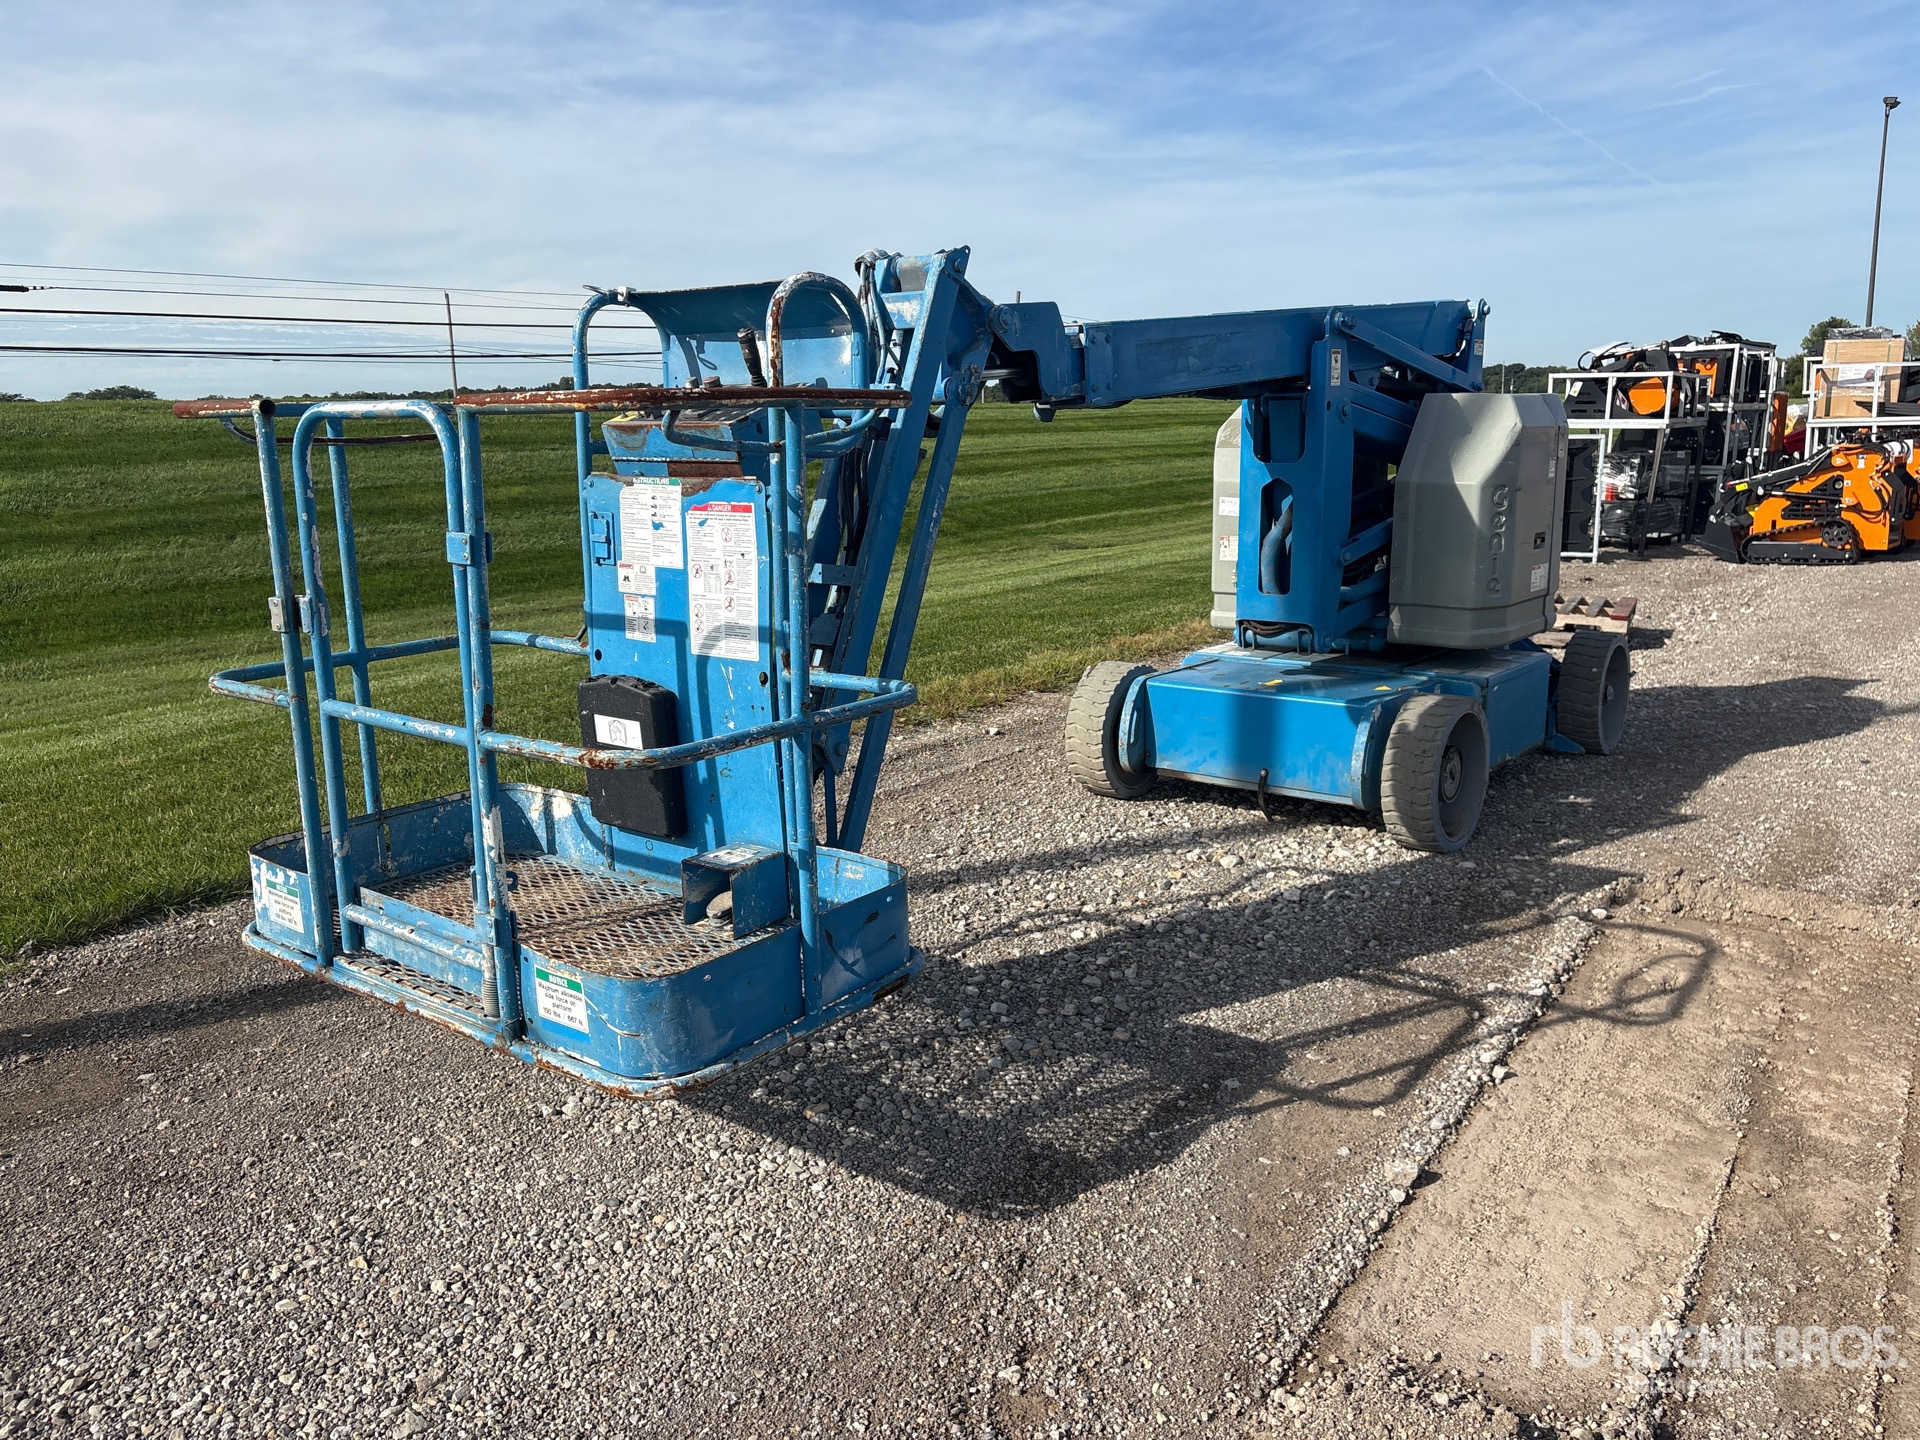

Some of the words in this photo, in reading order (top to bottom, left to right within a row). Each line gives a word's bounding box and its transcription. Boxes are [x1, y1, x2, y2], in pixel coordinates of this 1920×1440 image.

[711, 504, 732, 512] DANGER
[549, 974, 568, 987] NOTICE
[537, 981, 559, 994] Maximum
[561, 988, 583, 1002] allowable
[545, 992, 554, 1000] side
[555, 994, 568, 1004] force
[543, 1006, 552, 1015] 150
[552, 1001, 573, 1013] platform
